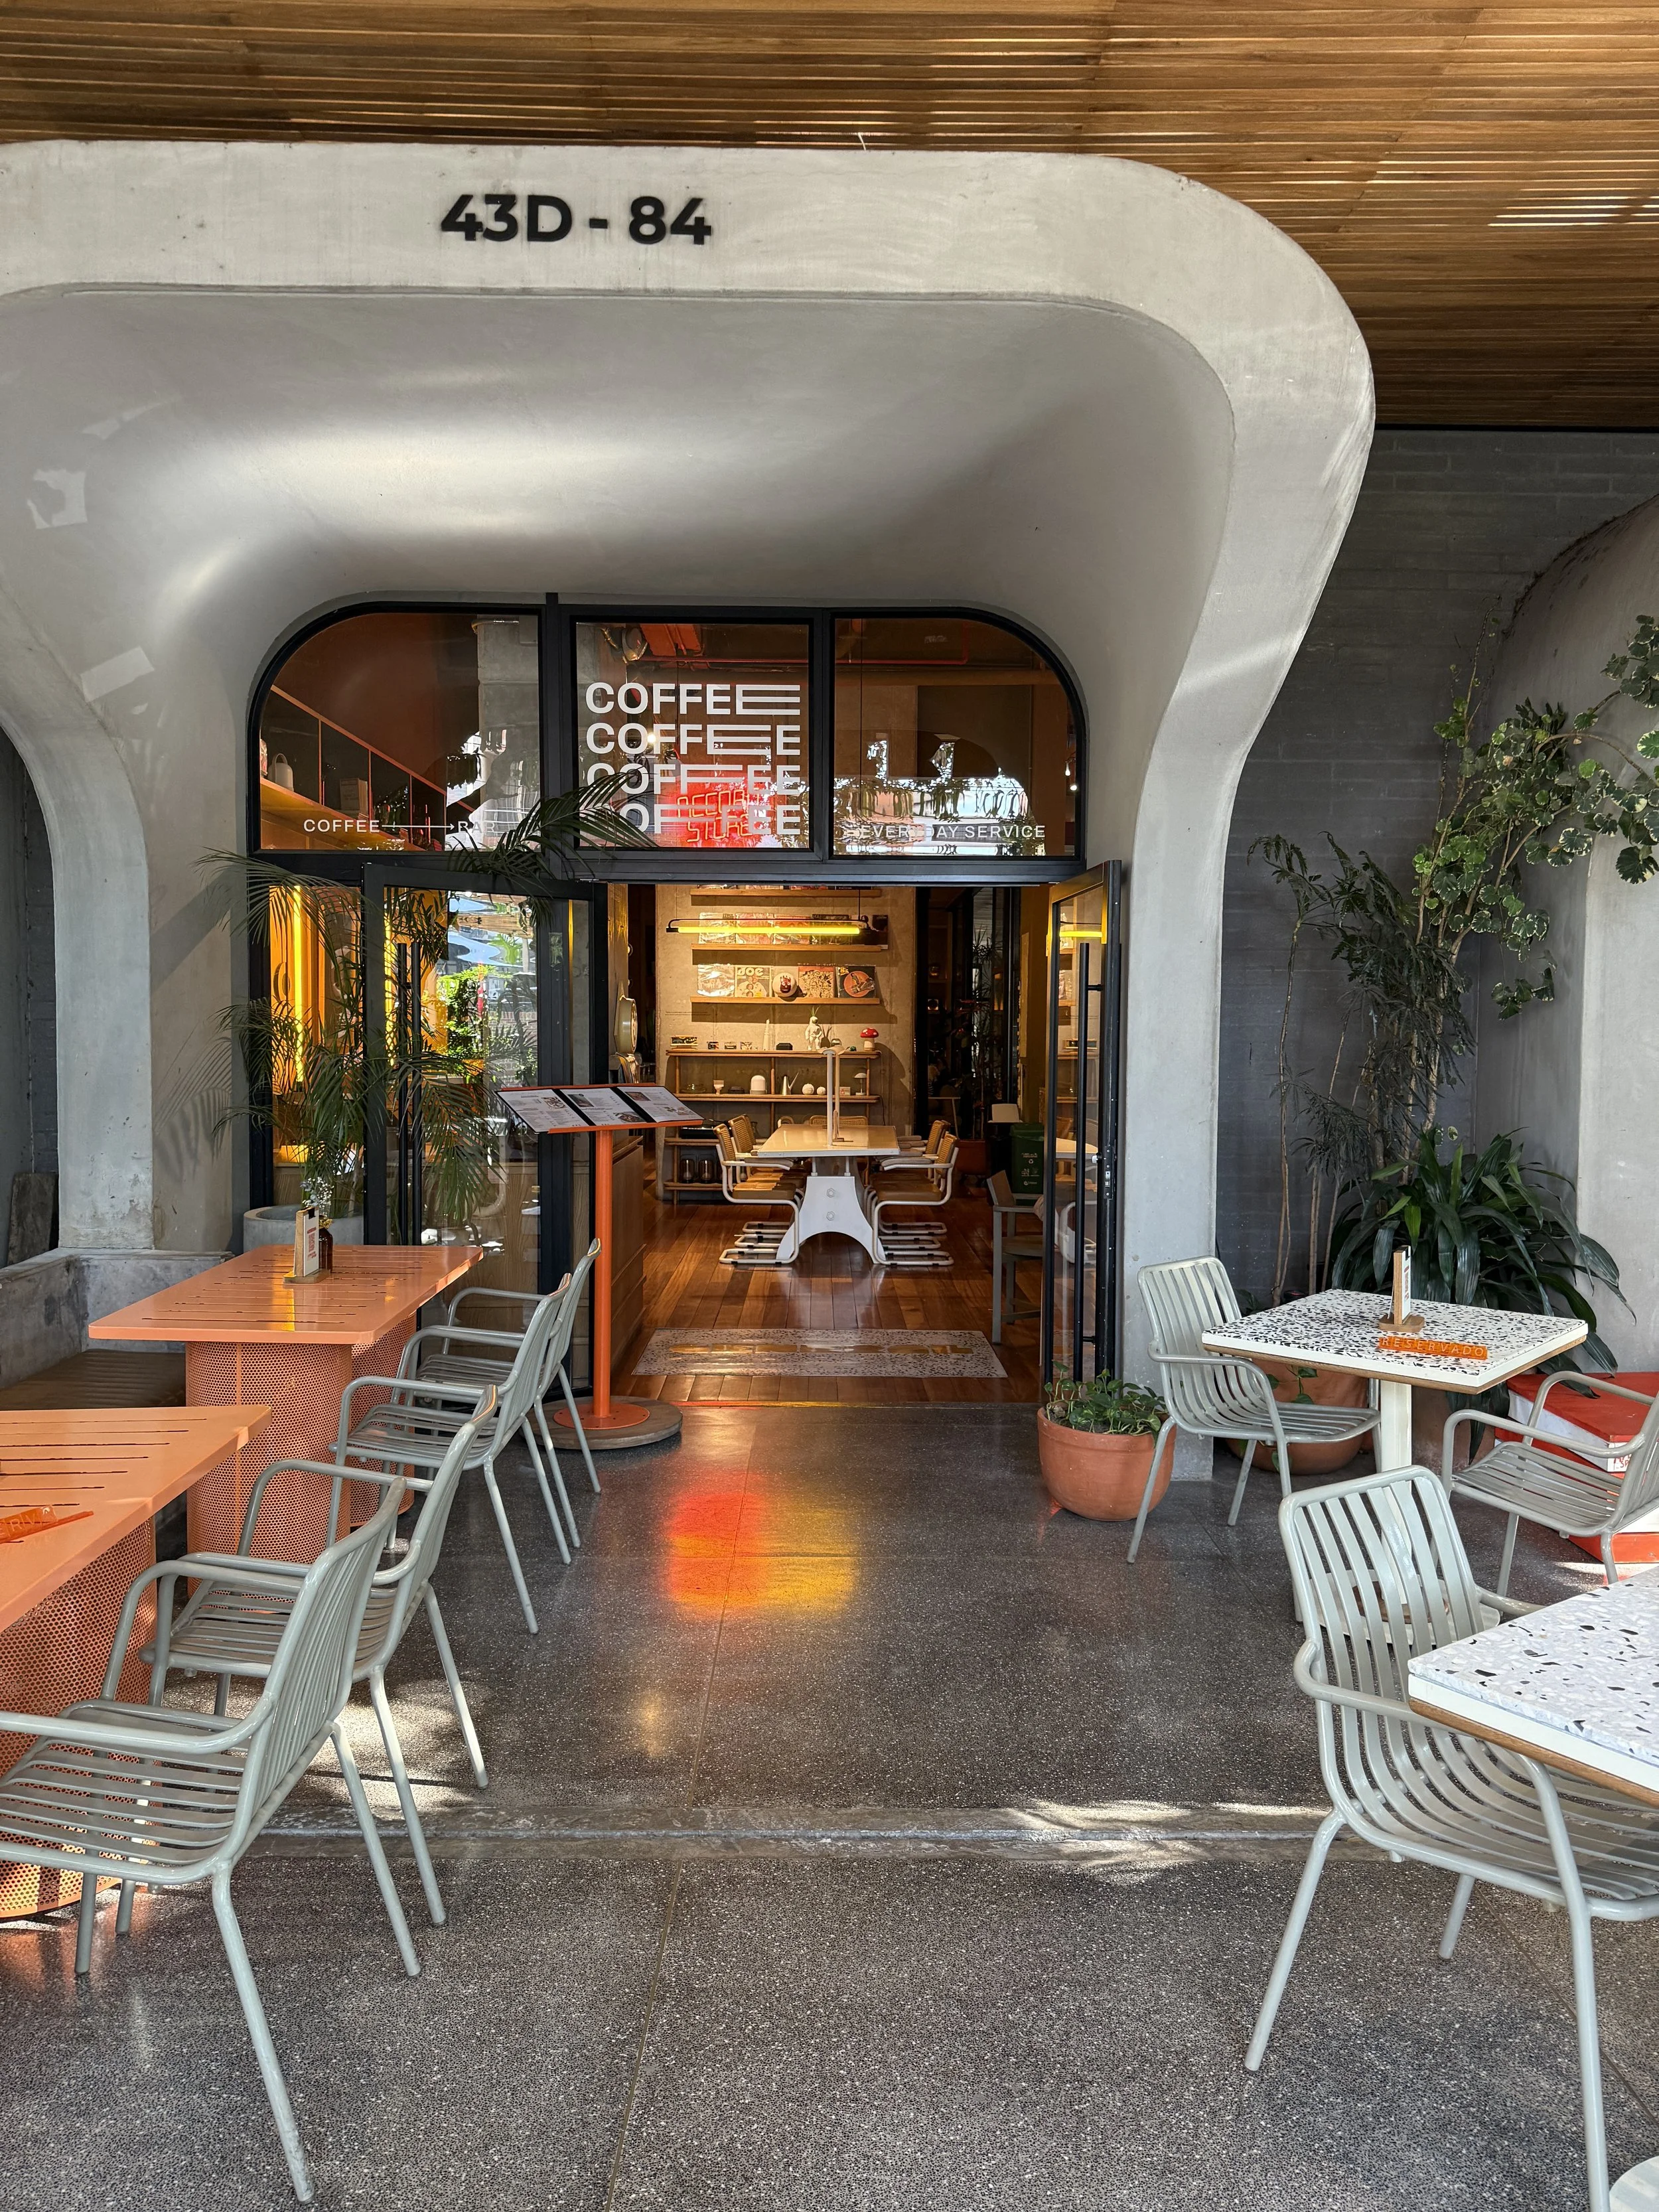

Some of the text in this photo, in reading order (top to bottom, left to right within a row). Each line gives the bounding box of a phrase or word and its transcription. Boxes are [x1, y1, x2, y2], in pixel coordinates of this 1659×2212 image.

[441, 194, 573, 242] 43D
[628, 195, 712, 246] 84
[585, 682, 800, 715] COFFEE
[585, 722, 800, 756] COFFEE
[303, 819, 496, 834] COFFEE BAR
[618, 804, 800, 836] OFFEE
[964, 825, 1046, 839] SERVICE
[1382, 1337, 1484, 1357] RESERVADO
